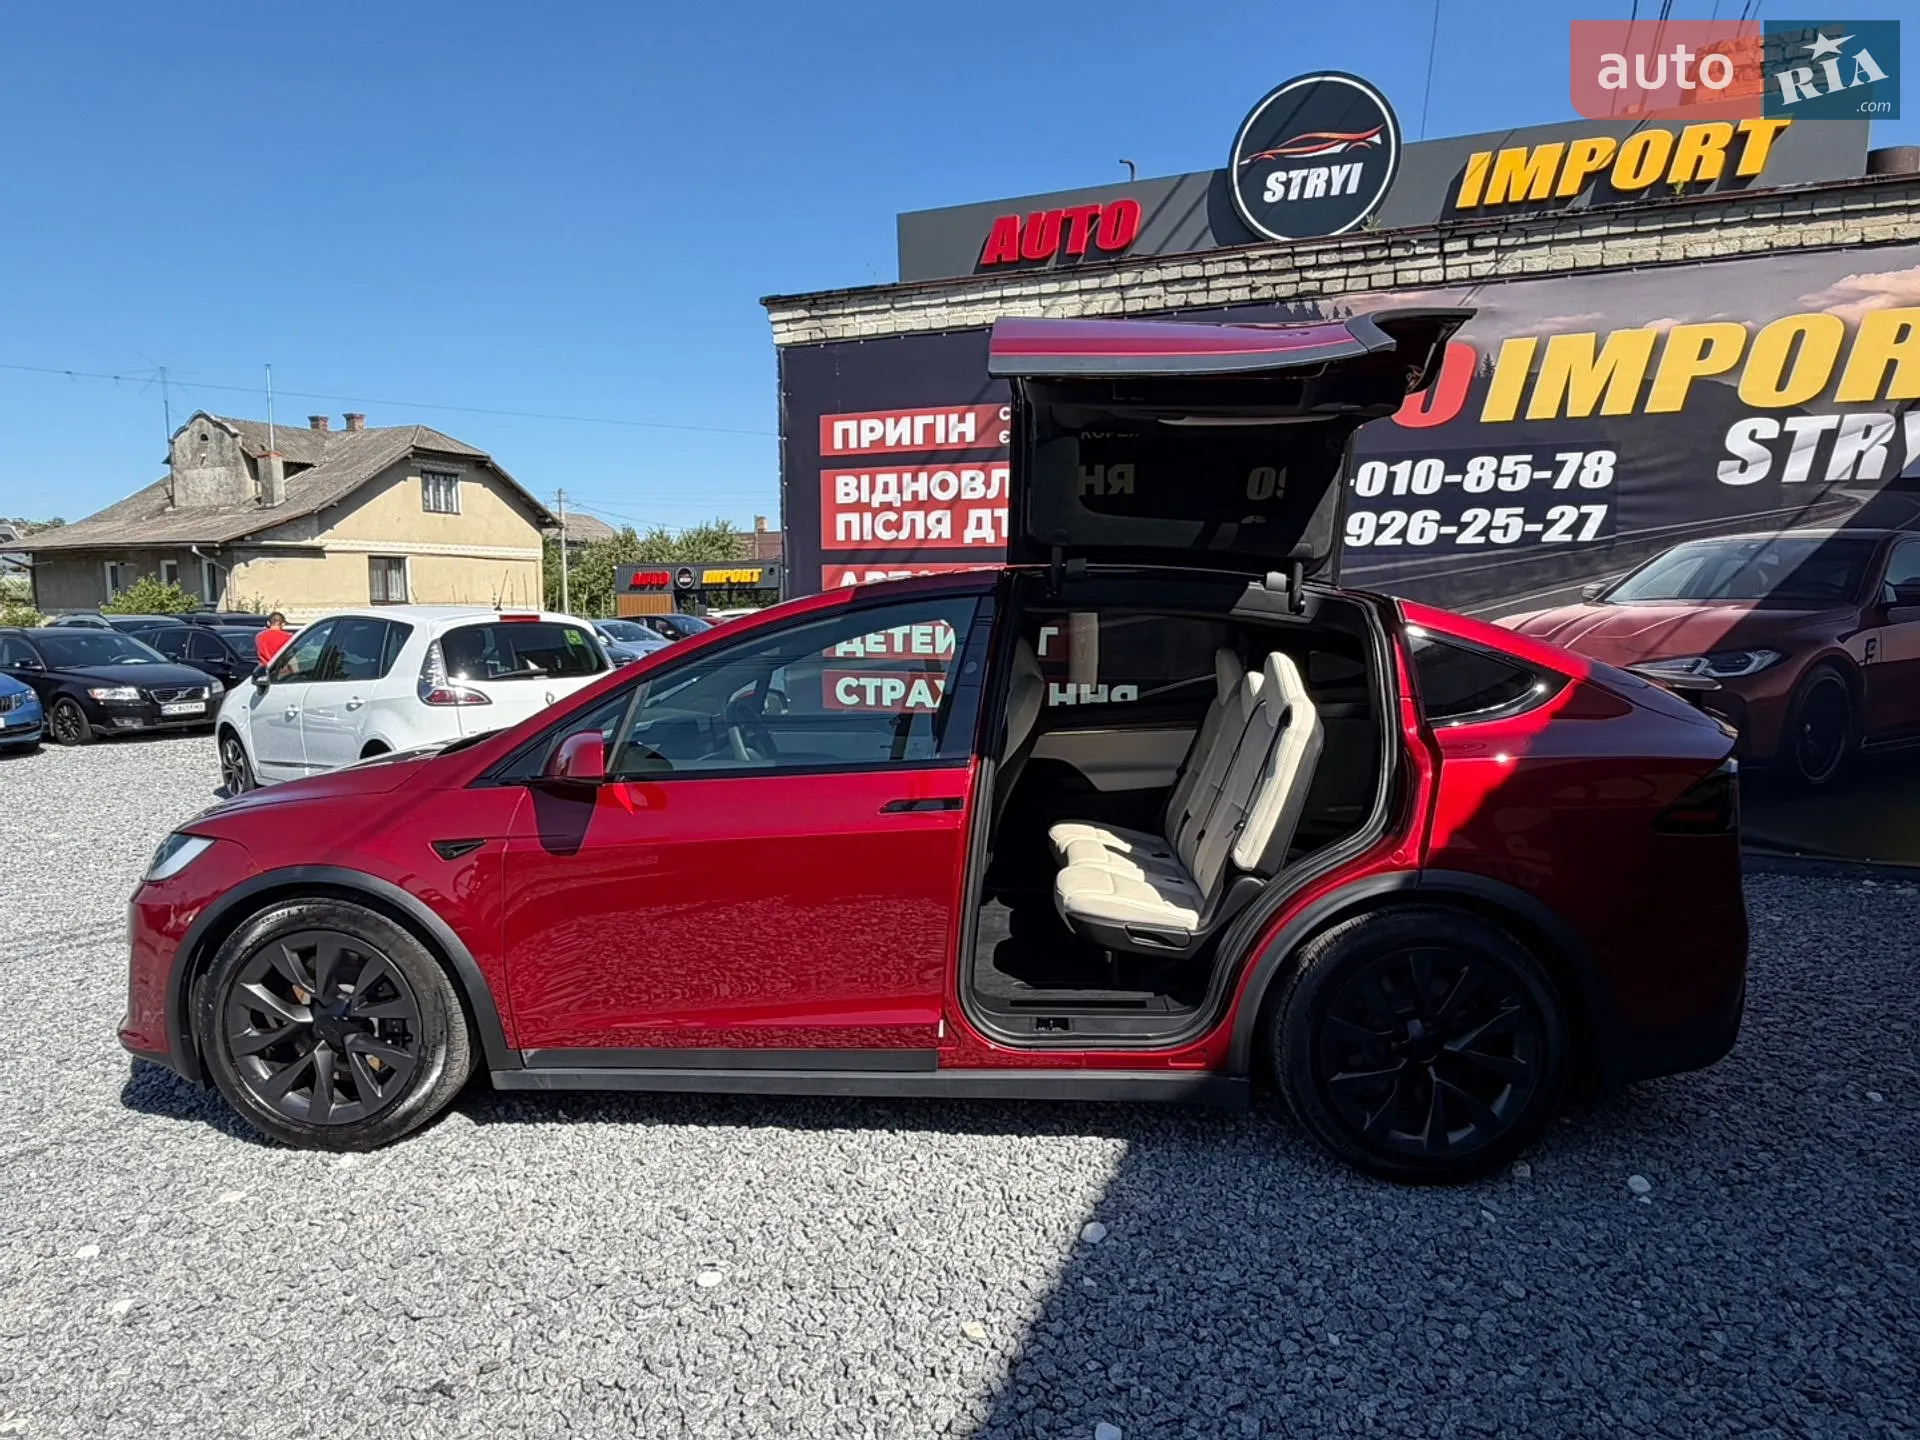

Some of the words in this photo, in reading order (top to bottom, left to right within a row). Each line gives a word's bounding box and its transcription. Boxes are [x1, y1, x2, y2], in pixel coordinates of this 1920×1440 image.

[1263, 162, 1364, 203] STRYI
[1455, 115, 1793, 210] IMPORT
[980, 199, 1142, 266] AUTO
[1480, 306, 1920, 424] IMPOR
[833, 412, 976, 450] ПРИГІН
[835, 510, 951, 541] ПІСЛЯ
